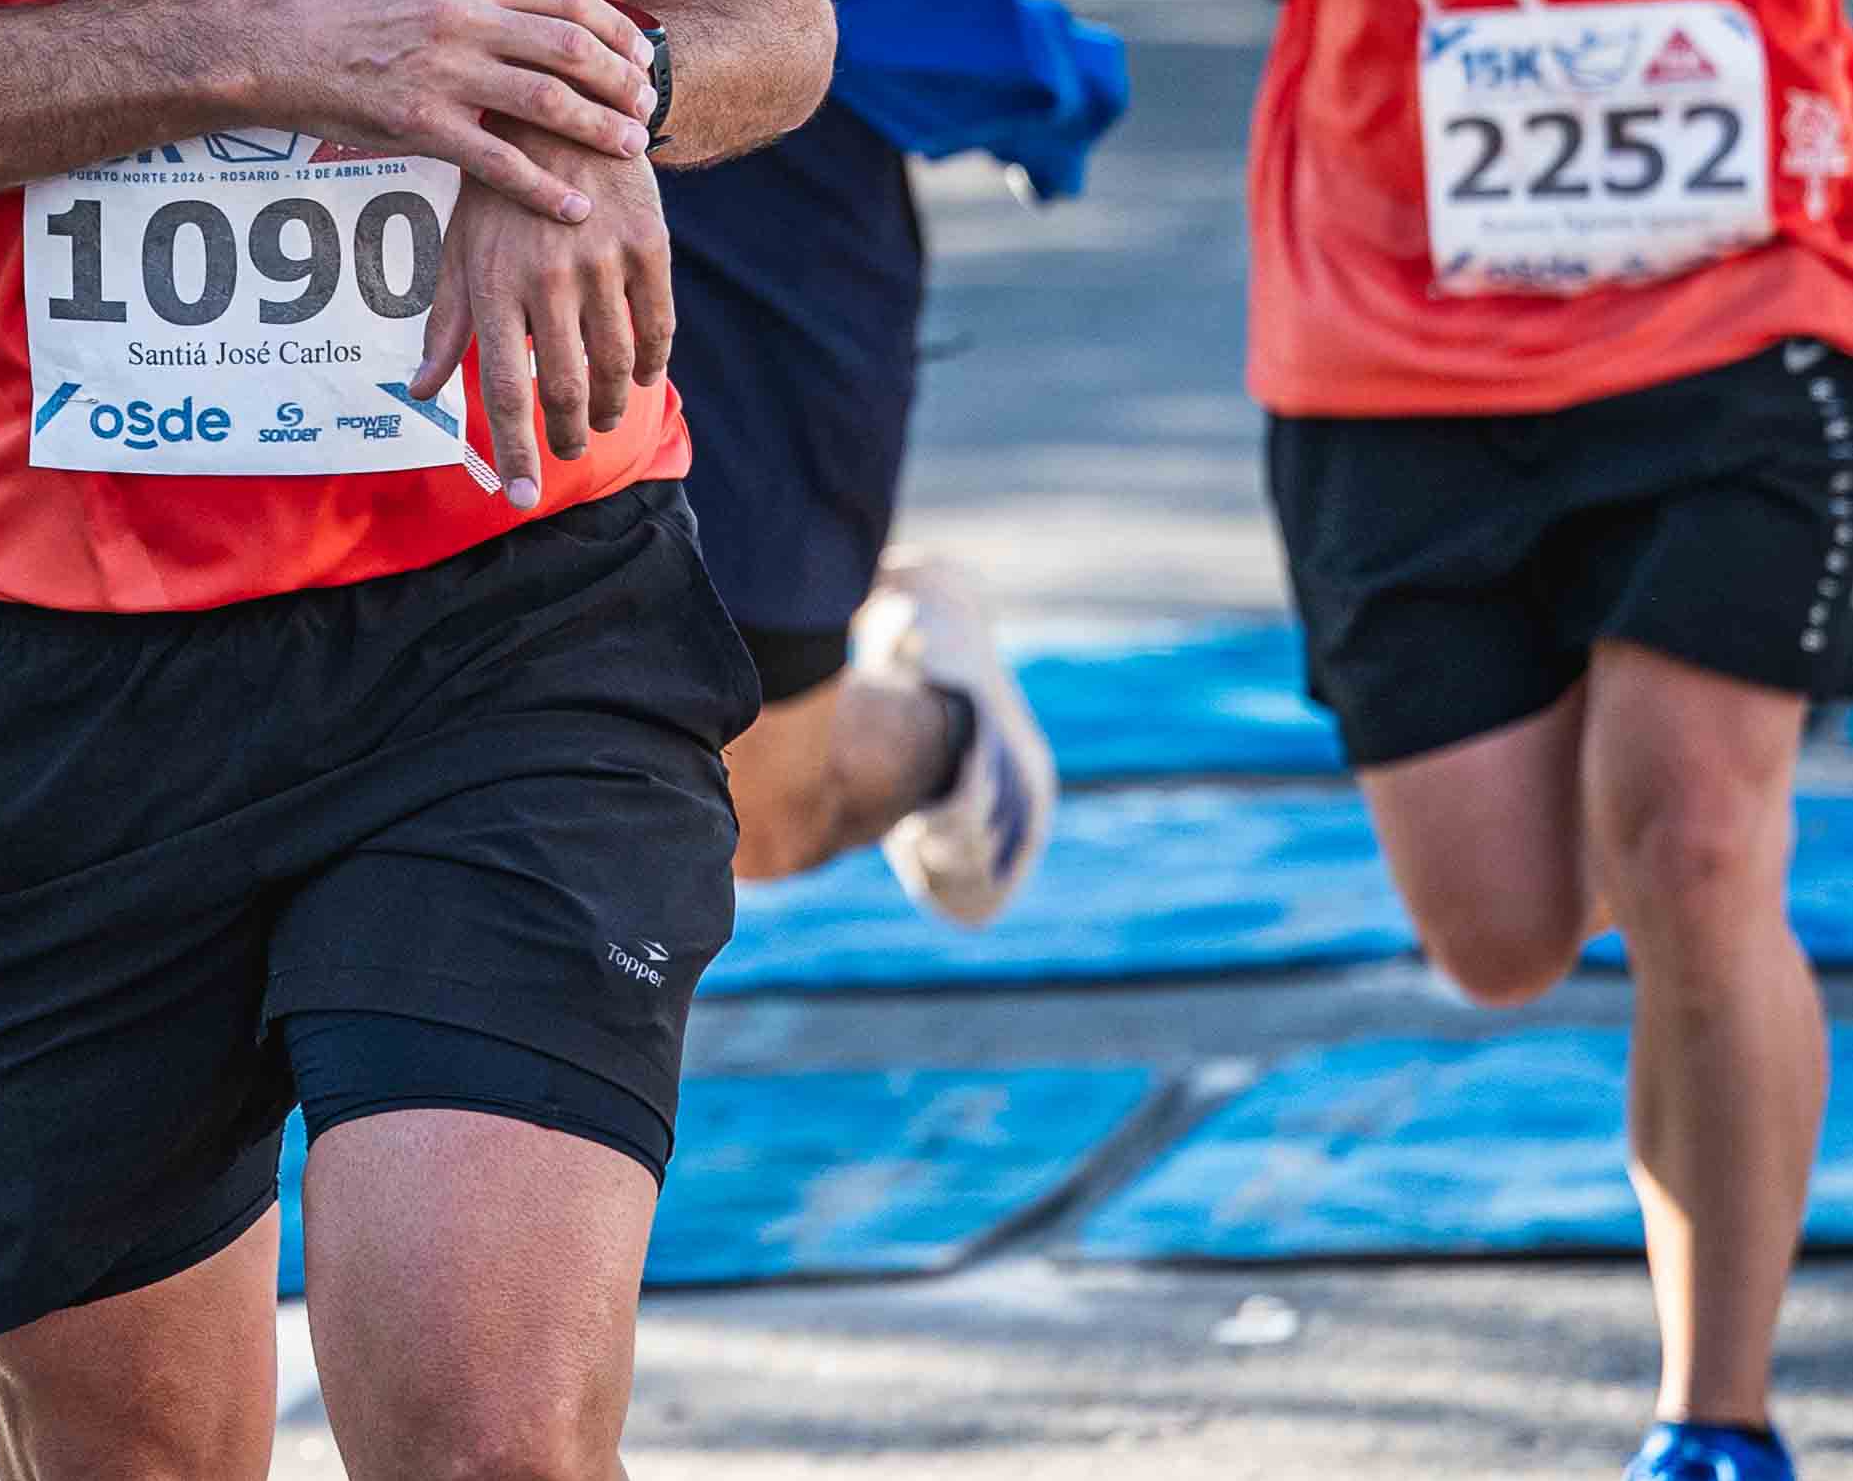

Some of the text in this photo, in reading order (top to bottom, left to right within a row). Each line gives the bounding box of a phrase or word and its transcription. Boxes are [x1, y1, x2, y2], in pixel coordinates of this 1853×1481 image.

[67, 169, 118, 183] PUERTO
[123, 171, 167, 183] NORTE
[172, 171, 205, 183] 2026
[220, 170, 280, 182] ROSARIO
[296, 169, 311, 181] 12
[315, 167, 332, 179] DE
[335, 166, 373, 179] ABRIL
[377, 162, 408, 175] 2026
[1444, 103, 1748, 203] 2252
[47, 191, 444, 326] 1090
[127, 339, 362, 366] Santiá José Carlos
[89, 396, 232, 443] osde
[607, 942, 667, 988] Topper
